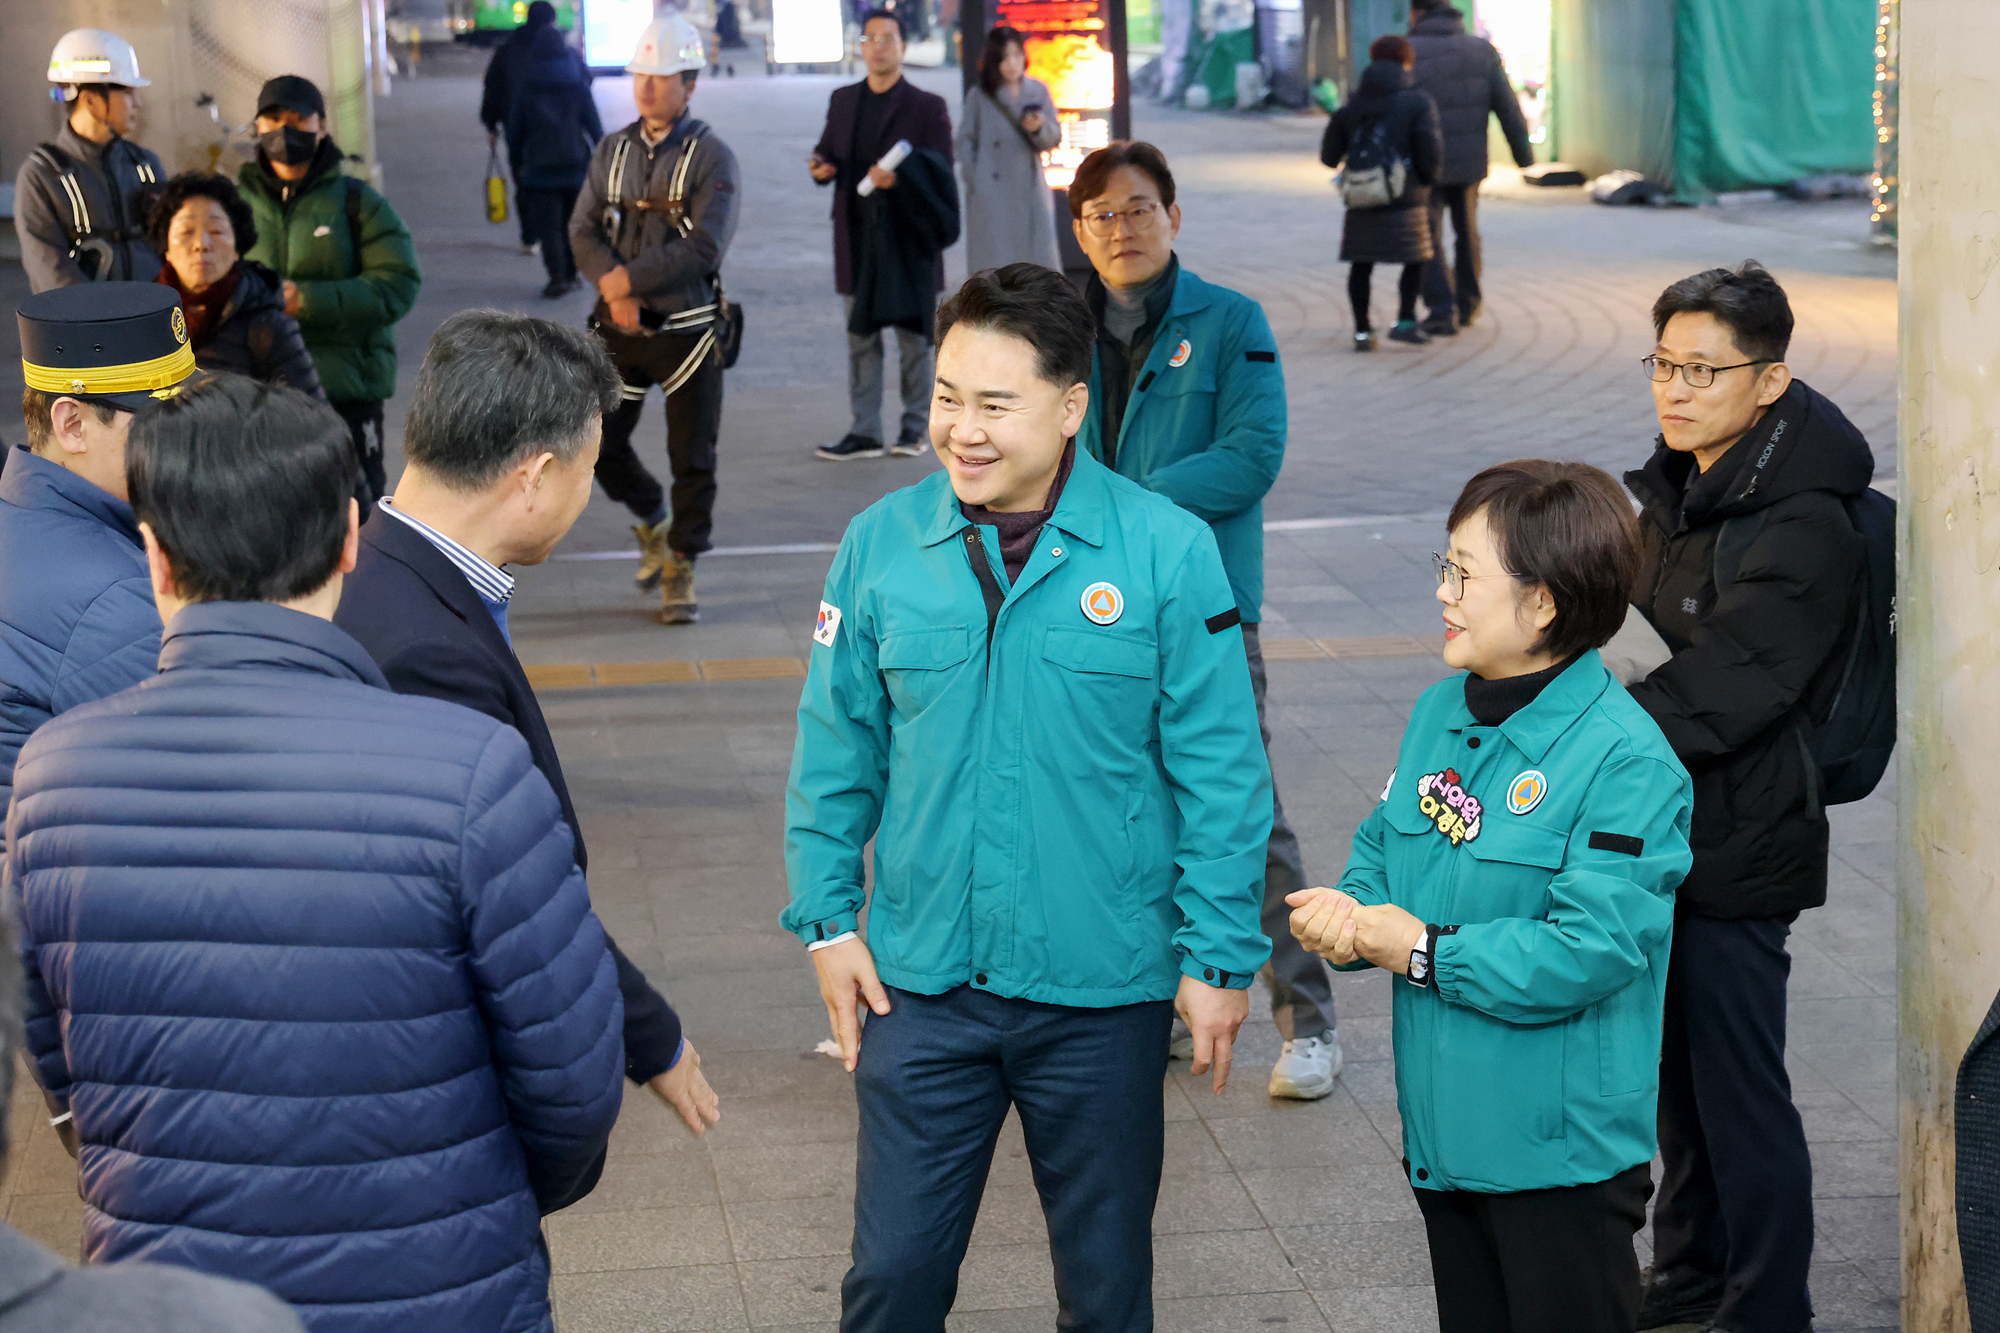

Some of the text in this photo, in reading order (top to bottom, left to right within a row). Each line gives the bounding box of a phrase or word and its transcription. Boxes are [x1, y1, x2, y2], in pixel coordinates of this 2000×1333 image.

[1756, 419, 1787, 469] KOLON SPORT
[1420, 796, 1466, 845] 이경숙
[1431, 772, 1481, 824] 시의원
